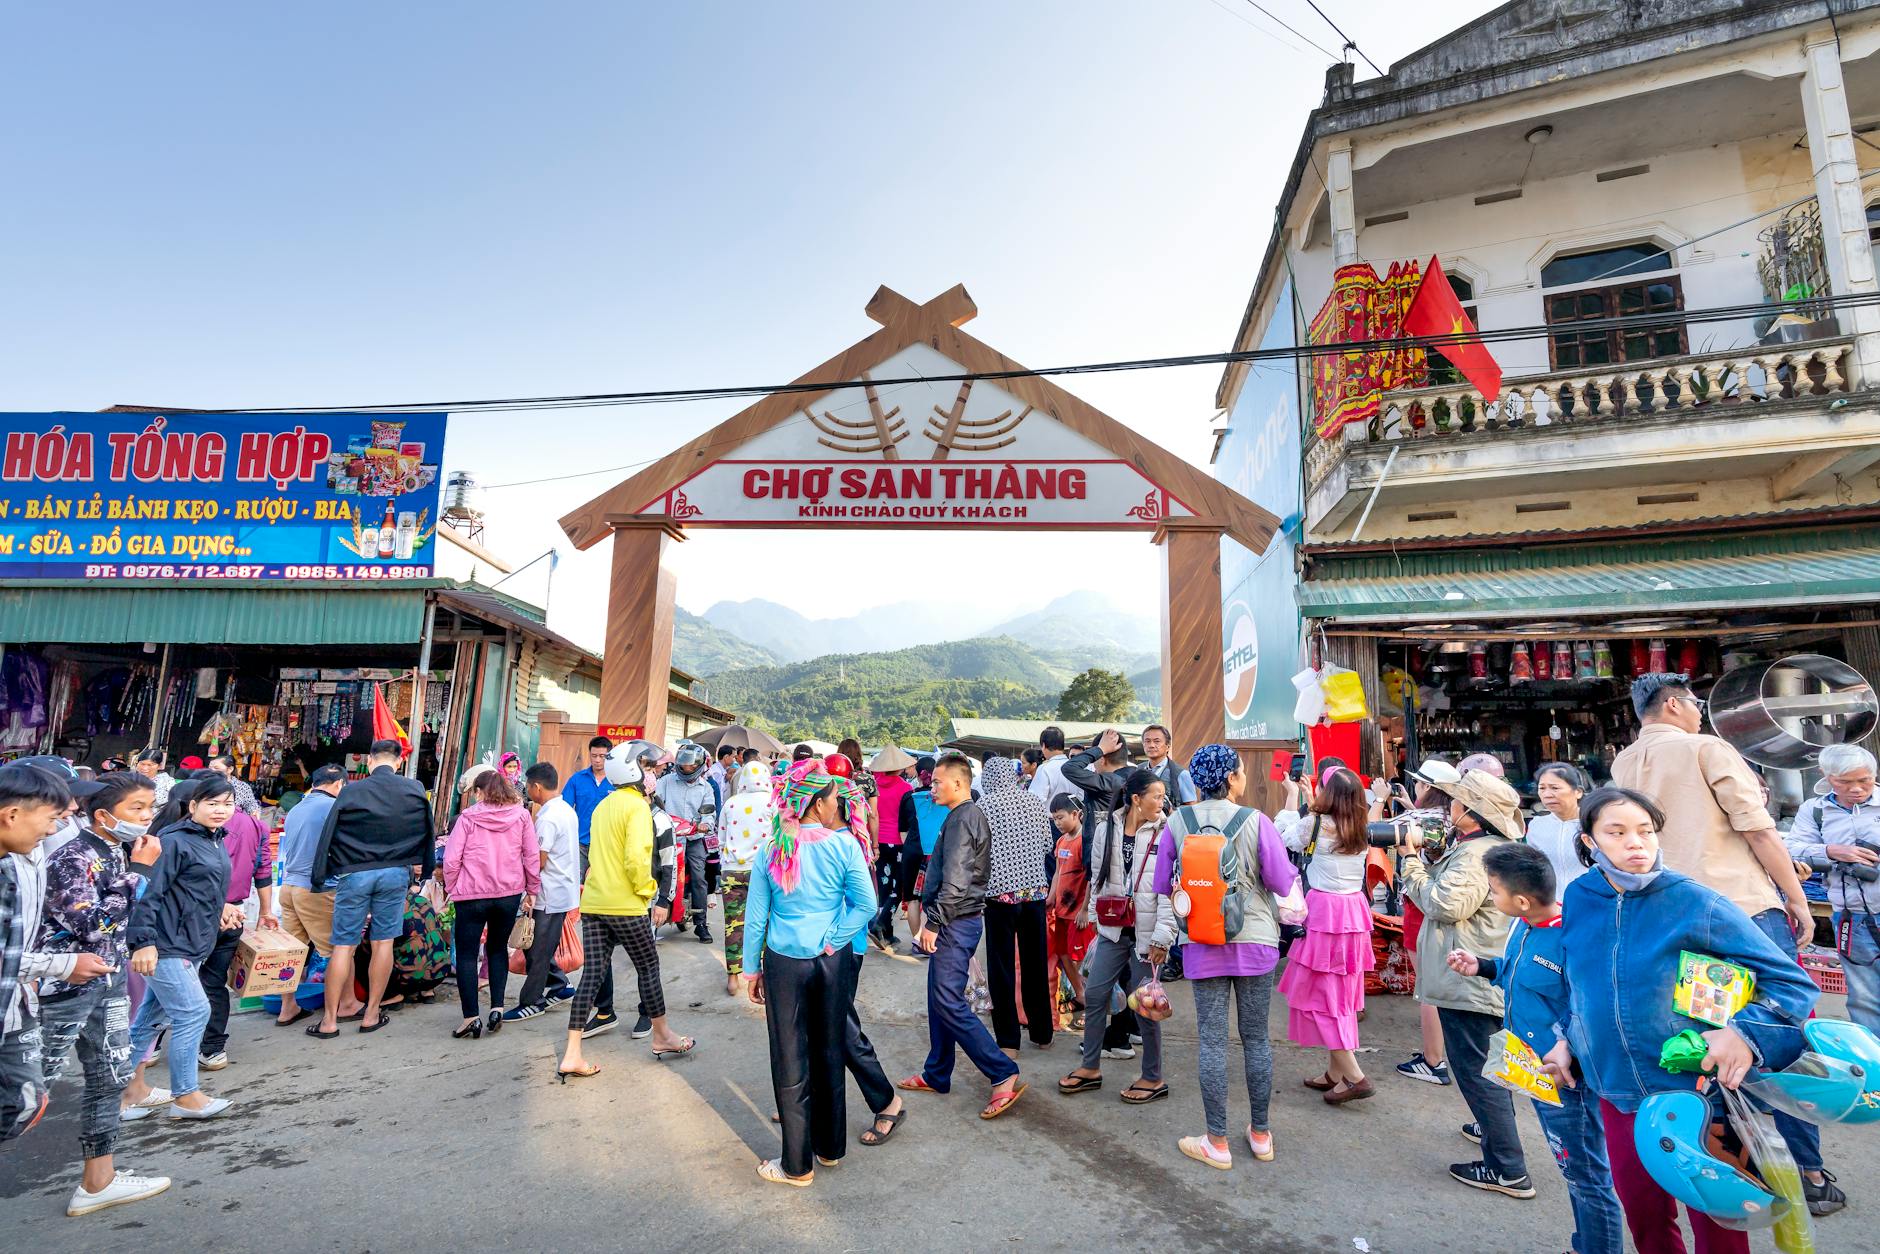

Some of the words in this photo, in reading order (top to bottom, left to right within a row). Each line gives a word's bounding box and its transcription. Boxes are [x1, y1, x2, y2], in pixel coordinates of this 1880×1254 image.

[2, 425, 94, 481] HÓA
[108, 416, 226, 481] TỔNG
[237, 426, 330, 490] HỢP
[743, 467, 833, 504] CHỢ
[840, 469, 931, 499] SAN
[940, 464, 1086, 499] THÀNG
[25, 495, 72, 519] BÁN
[76, 492, 102, 519] LẺ
[107, 495, 169, 519] BÁNH
[174, 500, 219, 524] KẸO
[235, 497, 298, 524] RƯỢU
[313, 500, 352, 520] BIA
[799, 502, 847, 517] KÍNH
[850, 502, 904, 517] CHÀO
[909, 501, 948, 517] QUÝ
[953, 501, 1027, 517] KHÁCH
[30, 529, 74, 555] SỮA
[90, 526, 122, 555] ĐỒ
[127, 535, 166, 555] GIA
[171, 535, 251, 560] DỤNG...
[86, 565, 117, 578] ĐT:
[122, 565, 264, 578] 0976.712.687
[284, 565, 429, 579] 0985.149.980
[1533, 954, 1562, 975] BASKETBALL
